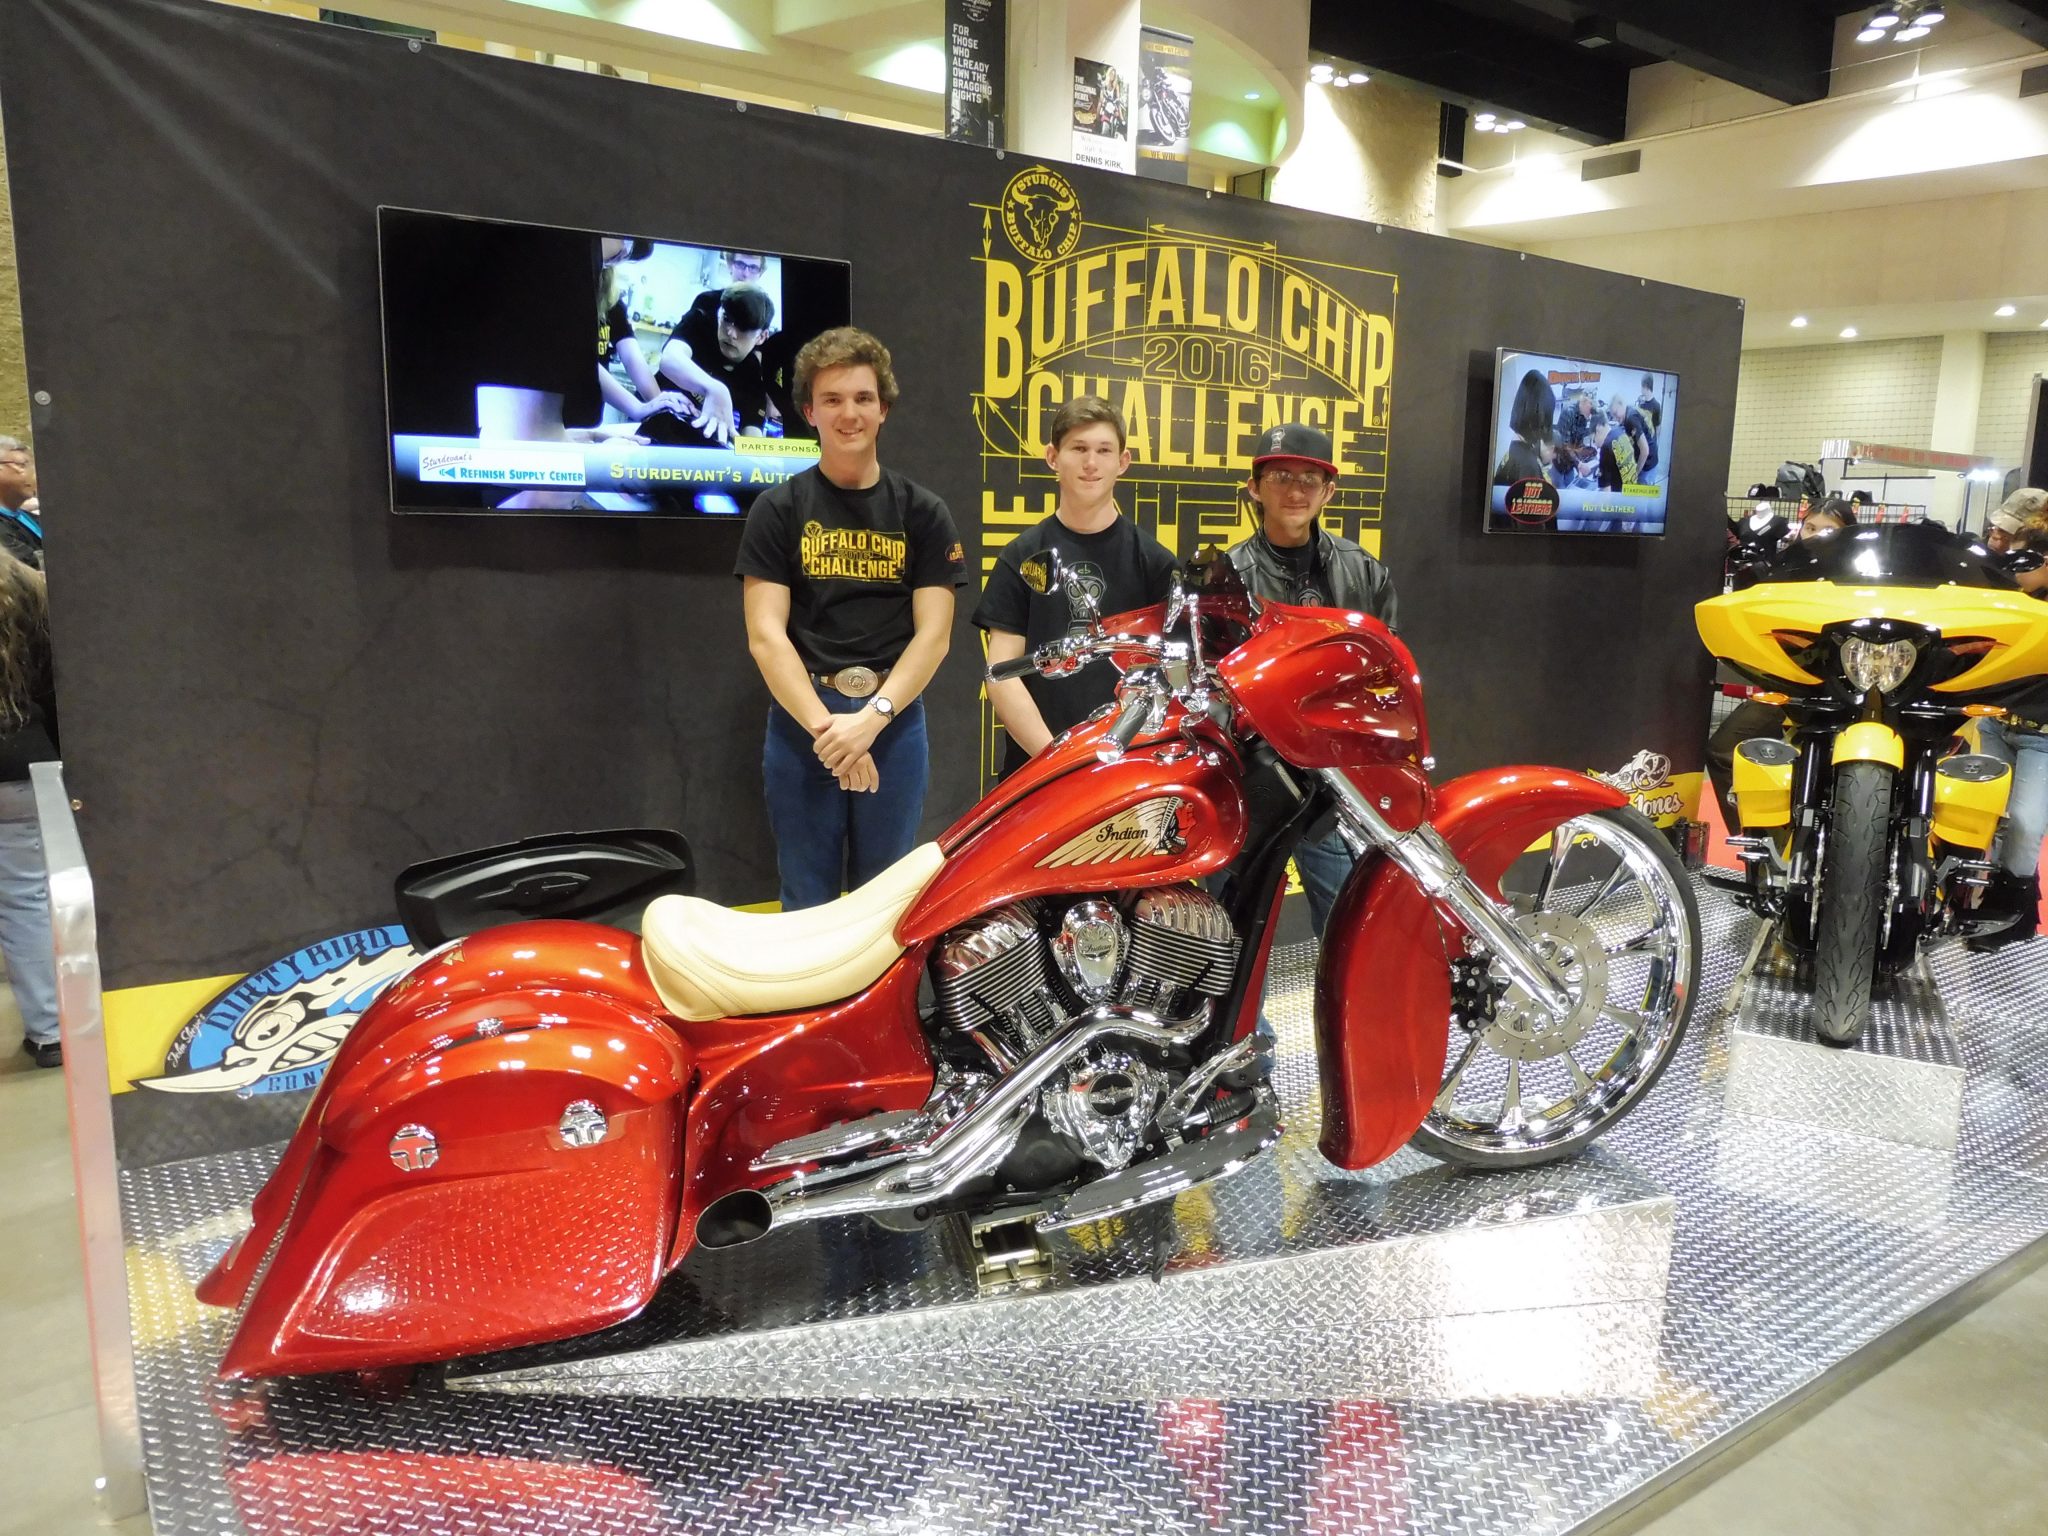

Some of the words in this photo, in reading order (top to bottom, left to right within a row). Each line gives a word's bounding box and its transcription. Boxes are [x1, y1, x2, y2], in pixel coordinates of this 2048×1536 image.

[953, 24, 969, 36] FOR
[952, 34, 978, 49] THOSE
[953, 45, 970, 58] WHO
[952, 57, 989, 72] ALREADY
[953, 67, 970, 80] OWN
[971, 71, 987, 83] THE
[953, 78, 992, 95] BRAGGING
[953, 88, 982, 103] RIGHTS
[1075, 153, 1103, 165] DENNIS
[1150, 150, 1161, 160] WE
[1016, 173, 1069, 198] STURGIS
[1006, 210, 1052, 259] BUFFALO
[1056, 222, 1077, 255] CHIP
[984, 246, 1261, 399] BUFFALO
[1281, 275, 1394, 428] CHIP
[1143, 335, 1272, 390] 2016
[741, 443, 775, 451] PARTS
[777, 445, 822, 454] SPONSO
[460, 467, 505, 480] REFINISH
[509, 469, 546, 481] SUPPLY
[549, 470, 584, 482] CENTER
[801, 531, 868, 565] BUFFALO
[871, 533, 906, 568] CHIP
[810, 555, 897, 579] CHALLENGE
[1096, 823, 1149, 843] Indian
[205, 956, 303, 1031] DIRTY
[305, 927, 392, 967] BIRD
